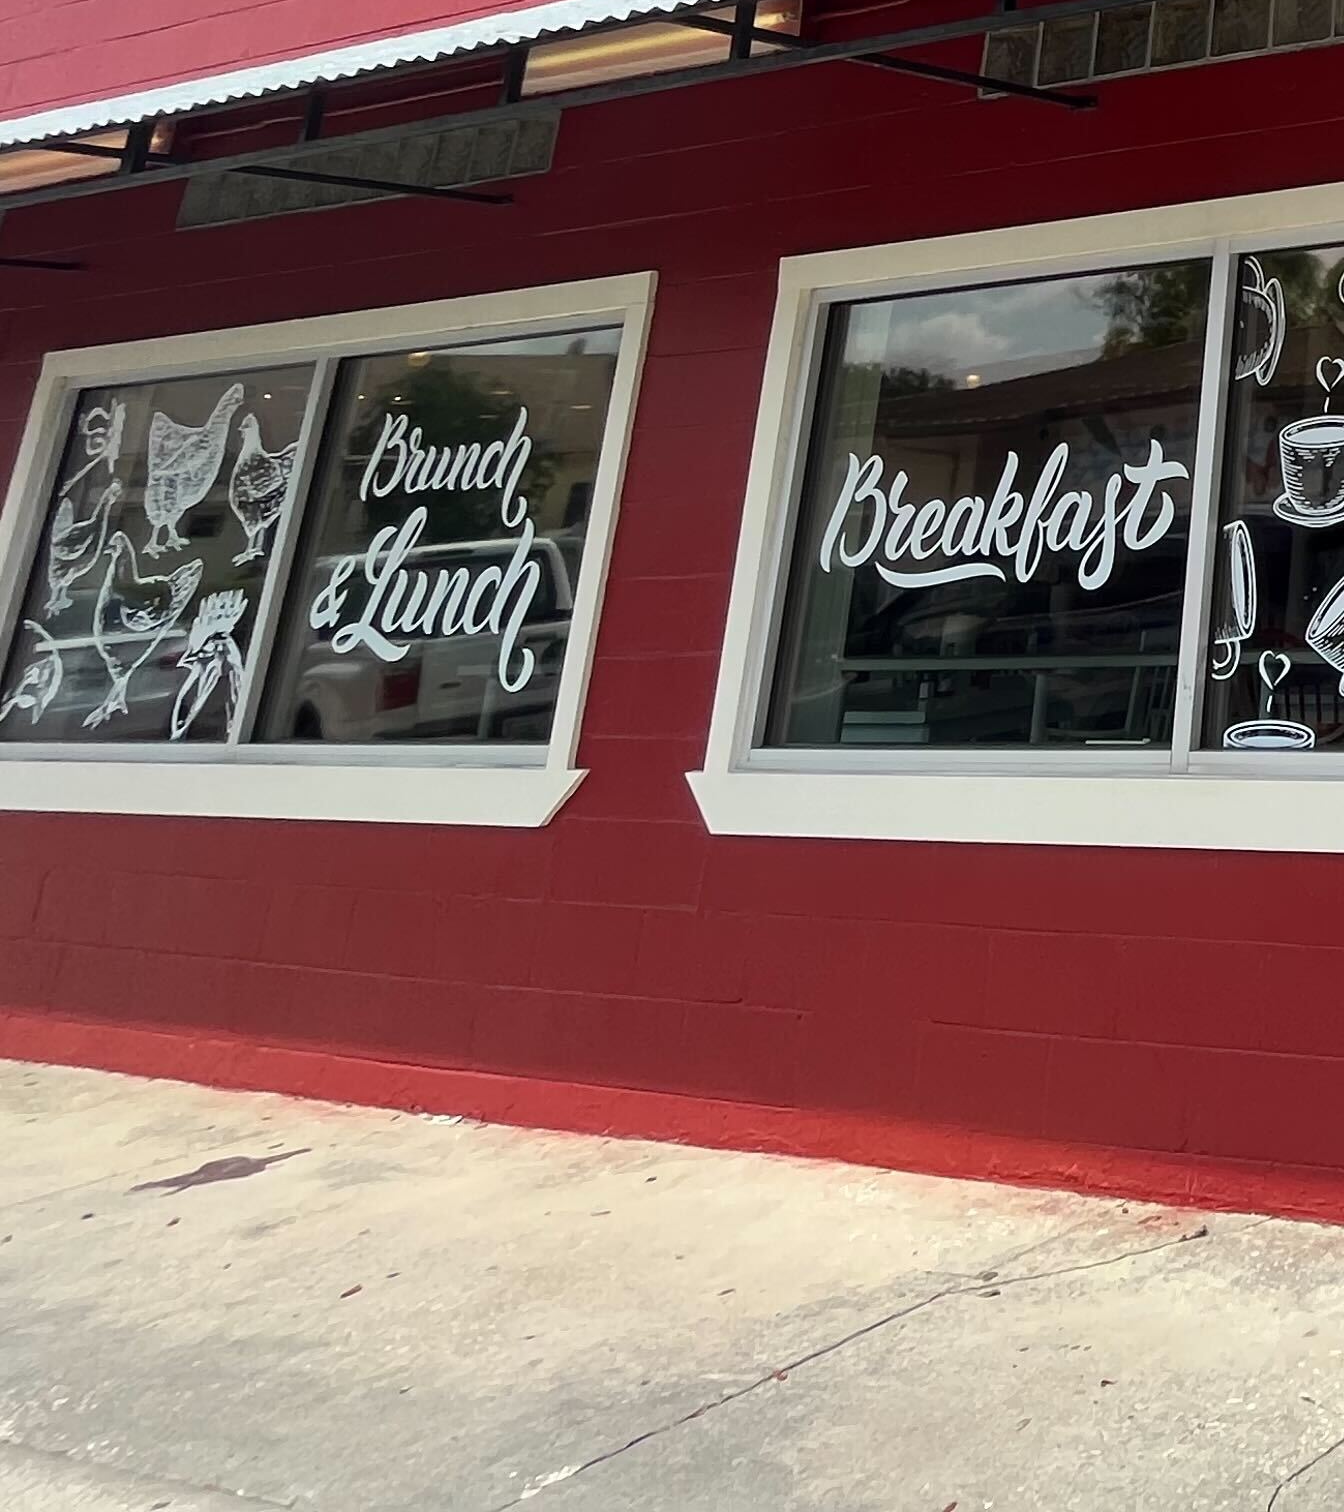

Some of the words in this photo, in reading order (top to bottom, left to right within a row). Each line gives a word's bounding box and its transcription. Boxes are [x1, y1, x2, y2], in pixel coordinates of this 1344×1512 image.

[360, 406, 532, 528] Brunch
[819, 438, 1190, 591] Breakfast
[309, 556, 355, 631] &
[331, 506, 541, 693] Lunch
